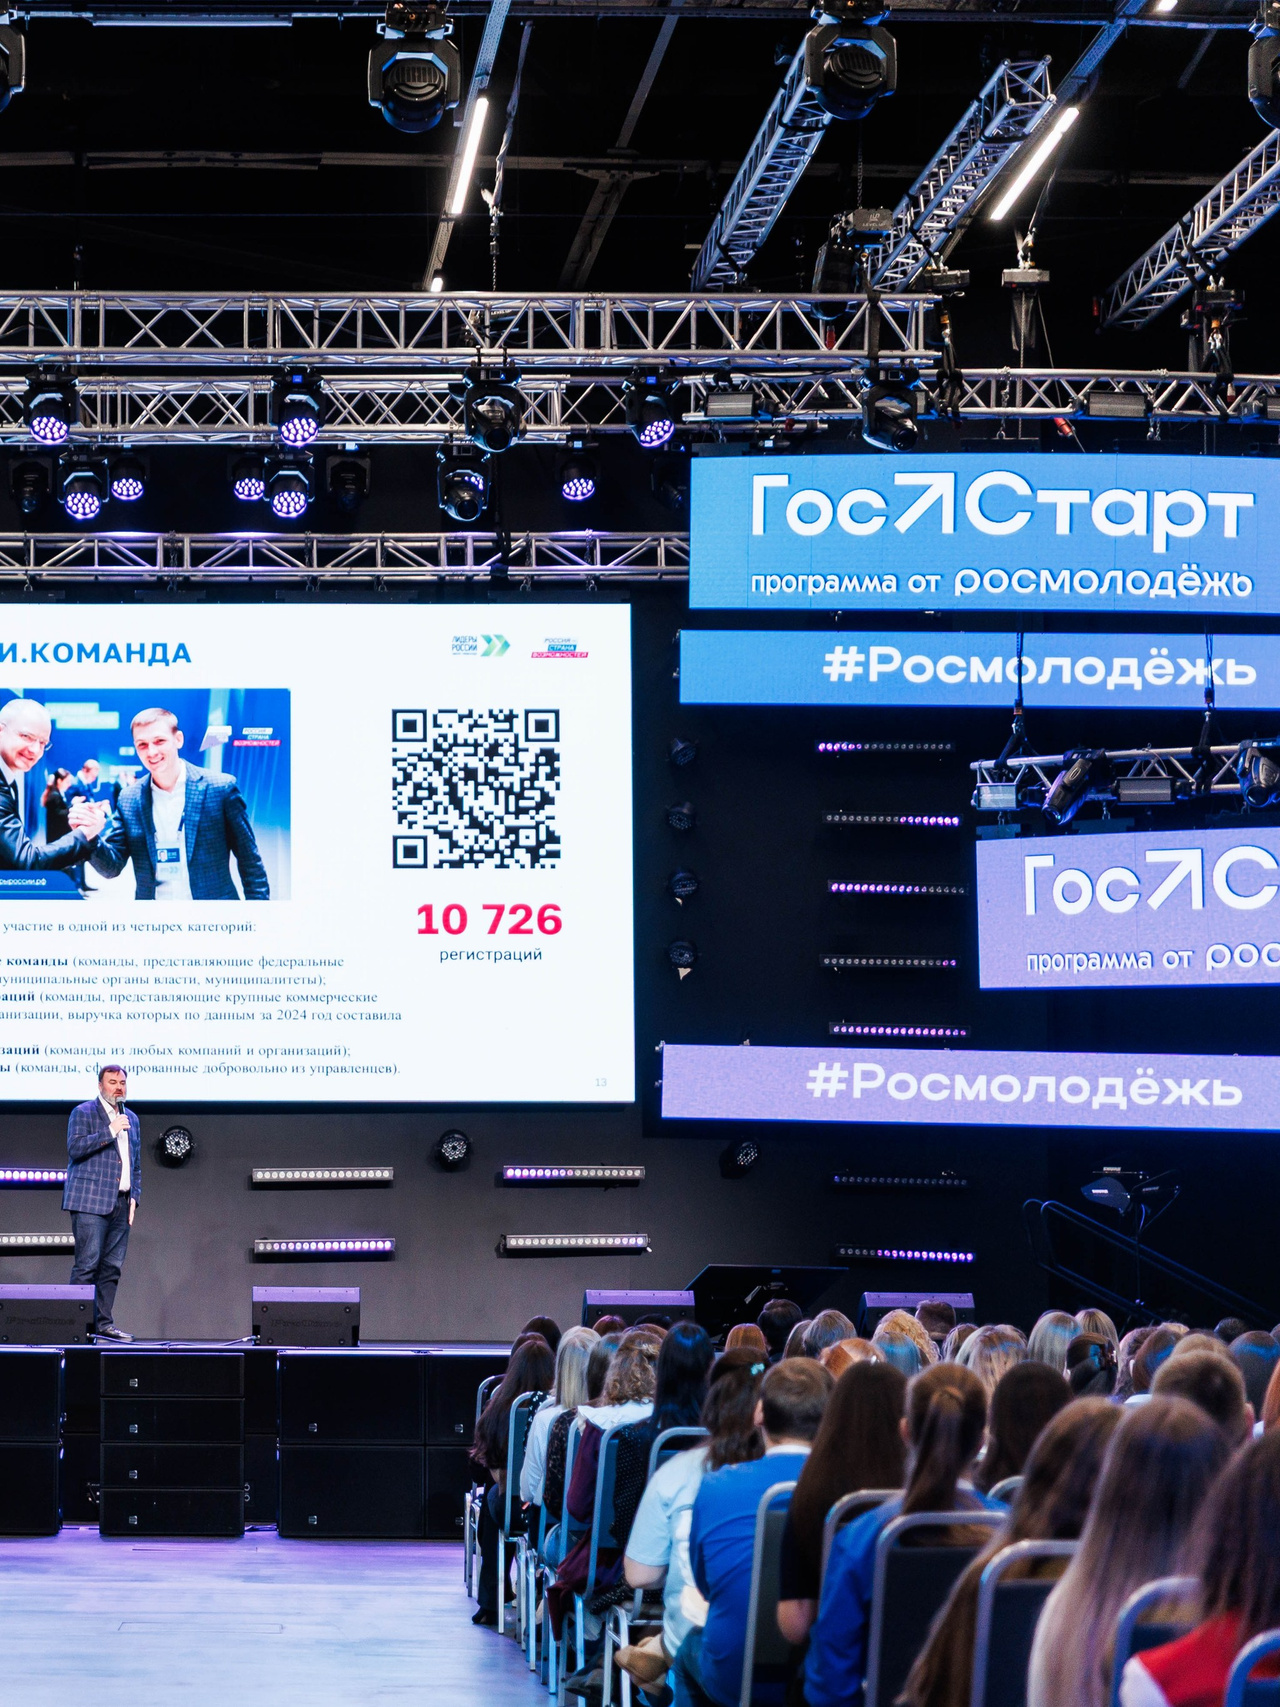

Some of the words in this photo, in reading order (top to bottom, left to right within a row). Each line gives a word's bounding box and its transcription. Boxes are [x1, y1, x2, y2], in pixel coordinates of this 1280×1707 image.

[752, 574, 897, 597] программа
[908, 574, 941, 594] от
[954, 563, 1253, 598] росмолодёжь
[823, 645, 1257, 691] #Росмолодёжь
[417, 903, 468, 935] 10
[482, 903, 563, 935] 726
[3, 922, 53, 934] участие
[57, 923, 65, 932] в
[69, 920, 107, 932] одной
[111, 923, 127, 932] из
[130, 923, 182, 934] четырех
[188, 920, 256, 934] категорий:
[7, 957, 68, 968] команды
[73, 956, 138, 968] (команды,
[144, 958, 253, 970] представляющие
[258, 955, 344, 970] федеральные
[440, 948, 543, 964] регистраций
[1027, 951, 1152, 976] программа
[1162, 951, 1193, 970] от
[102, 976, 149, 987] органы
[154, 976, 200, 986] власти,
[205, 974, 326, 988] муниципалитеты);
[40, 991, 105, 1003] (команды,
[110, 993, 220, 1005] представляющие
[226, 993, 281, 1005] крупные
[286, 993, 377, 1005] коммерческие
[68, 1011, 122, 1023] выручка
[127, 1011, 179, 1023] которых
[184, 1011, 201, 1021] по
[204, 1011, 254, 1022] данным
[259, 1011, 273, 1021] за
[277, 1008, 306, 1021] 2024
[312, 1011, 332, 1022] год
[336, 1011, 402, 1021] составила
[44, 1044, 106, 1057] (команды
[110, 1047, 125, 1056] из
[129, 1043, 173, 1055] любых
[179, 1043, 241, 1055] компаний
[246, 1047, 255, 1056] и
[258, 1044, 350, 1059] организаций);
[15, 1062, 80, 1074] (команды,
[202, 1061, 287, 1076] добровольно
[291, 1064, 306, 1074] из
[310, 1062, 400, 1076] управленцев).
[595, 1078, 608, 1087] 13
[805, 1061, 1243, 1110] #Росмолодёжь
